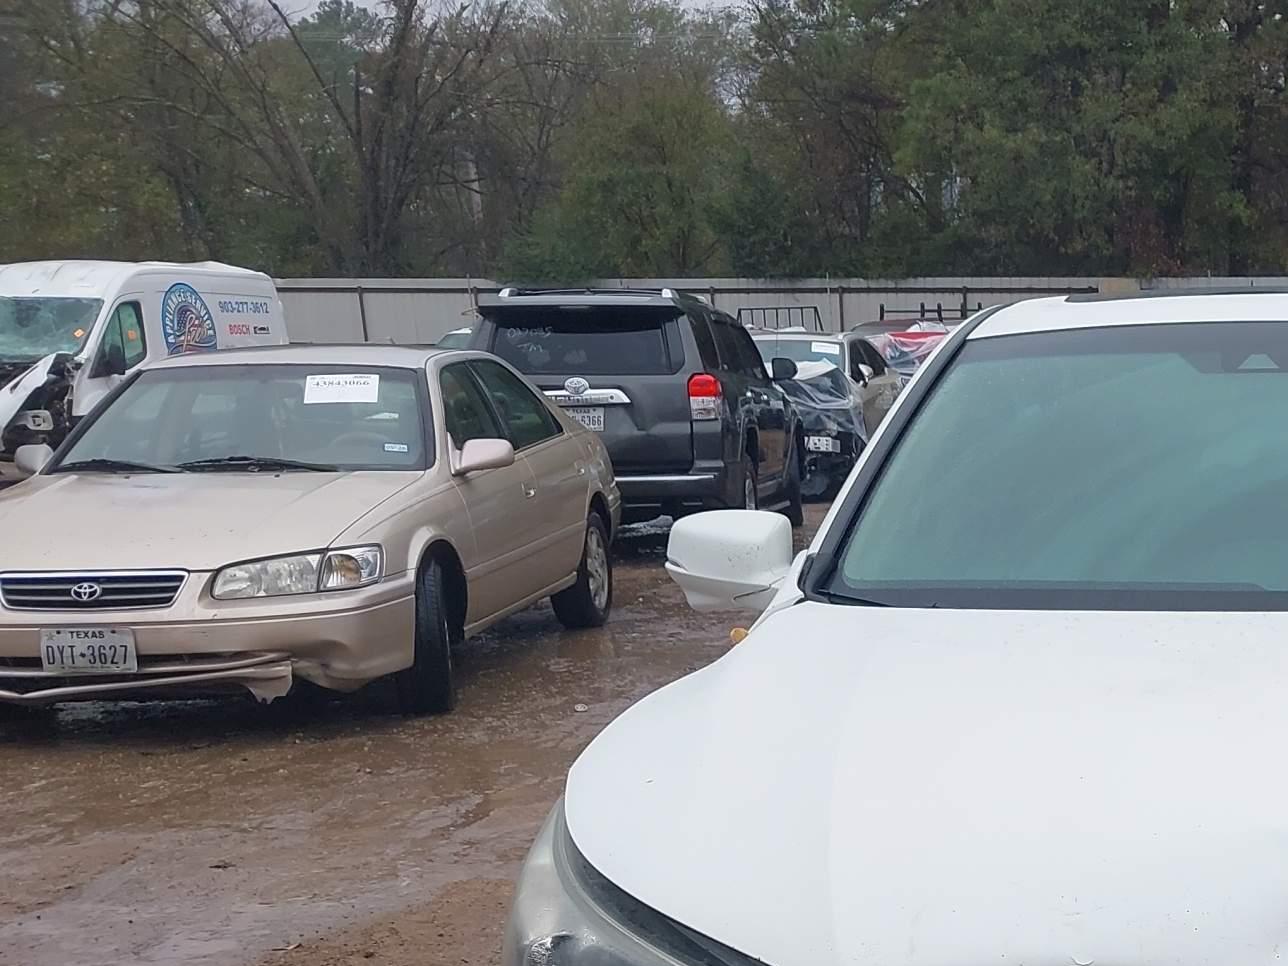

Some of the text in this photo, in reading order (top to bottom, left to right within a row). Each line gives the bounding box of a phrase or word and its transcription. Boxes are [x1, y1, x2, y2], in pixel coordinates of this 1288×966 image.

[187, 291, 216, 336] SERVICE
[228, 324, 251, 336] BOSCH
[68, 630, 105, 639] TEXAS
[46, 645, 128, 665] DYT 3627
